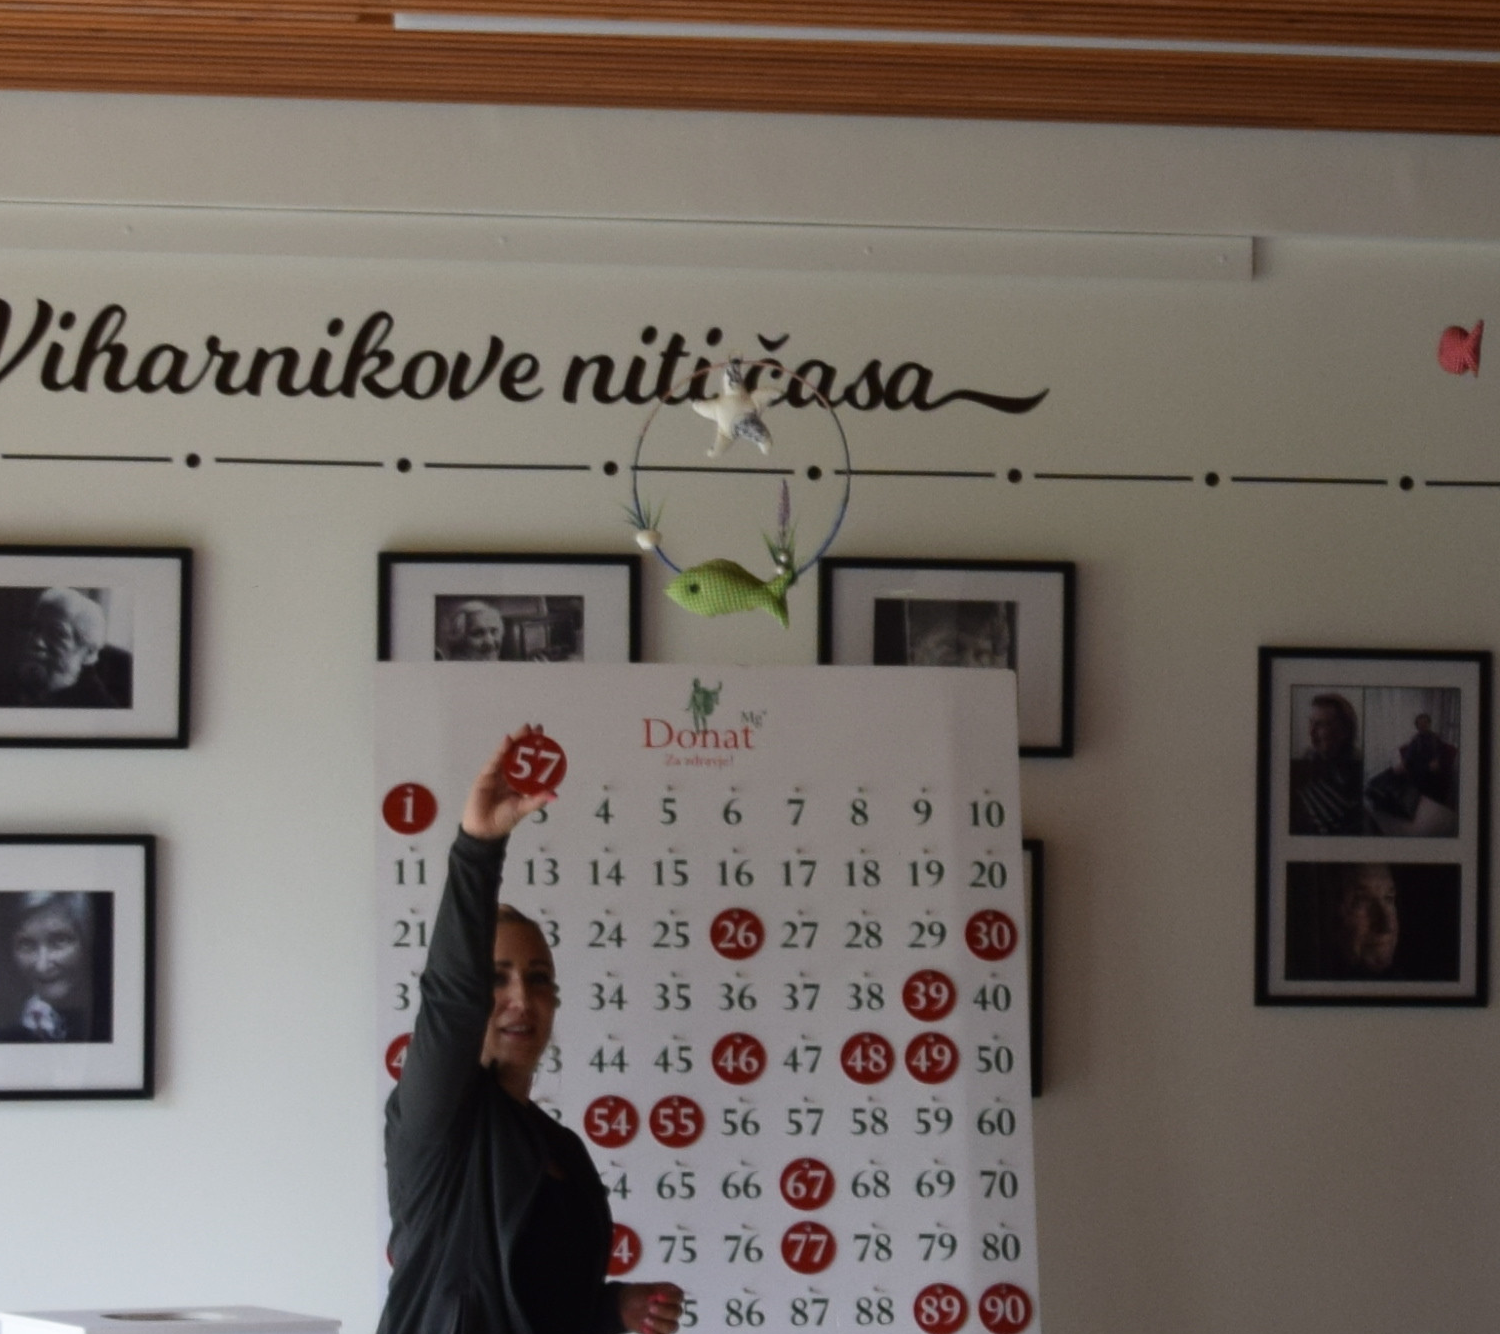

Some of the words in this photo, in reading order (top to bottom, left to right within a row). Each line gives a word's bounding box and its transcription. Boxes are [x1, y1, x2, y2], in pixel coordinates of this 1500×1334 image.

[642, 718, 755, 750] Donat
[509, 747, 561, 784] 57
[403, 795, 414, 824] 1
[595, 799, 613, 825] 4
[662, 797, 677, 825] 5
[722, 799, 743, 825] 6
[787, 798, 805, 826] 7
[850, 799, 869, 826] 8
[912, 799, 933, 824] 9
[970, 800, 1005, 828] 10
[396, 858, 426, 885] 11
[526, 857, 560, 886] 13
[590, 859, 625, 887] 14
[655, 859, 689, 887] 15
[719, 860, 754, 887] 16
[782, 859, 817, 888] 17
[846, 860, 881, 887] 18
[909, 859, 945, 887] 19
[969, 860, 1008, 889] 20
[392, 920, 428, 948] 21
[588, 920, 626, 948] 24
[652, 920, 690, 948] 25
[718, 919, 758, 949] 26
[781, 920, 819, 949] 27
[845, 921, 883, 949] 28
[908, 920, 947, 949] 29
[972, 921, 1011, 949] 30
[590, 982, 627, 1011] 34
[655, 982, 692, 1011] 35
[719, 982, 757, 1011] 36
[783, 982, 821, 1011] 37
[848, 982, 885, 1011] 38
[911, 980, 950, 1010] 39
[973, 984, 1012, 1011] 40
[589, 1046, 628, 1073] 44
[654, 1045, 693, 1073] 45
[717, 1045, 759, 1073] 46
[783, 1045, 822, 1073] 47
[847, 1044, 887, 1073] 48
[911, 1043, 952, 1073] 49
[977, 1045, 1014, 1074] 50
[593, 1107, 631, 1137] 54
[658, 1107, 696, 1137] 55
[723, 1108, 761, 1136] 56
[786, 1107, 824, 1136] 57
[852, 1107, 889, 1135] 58
[916, 1107, 954, 1135] 59
[976, 1108, 1016, 1136] 60
[656, 1171, 696, 1199] 65
[721, 1173, 762, 1199] 66
[785, 1169, 827, 1199] 67
[851, 1170, 891, 1198] 68
[915, 1169, 956, 1198] 69
[979, 1170, 1019, 1199] 70
[658, 1235, 697, 1264] 75
[724, 1234, 764, 1263] 76
[787, 1232, 828, 1263] 77
[853, 1233, 893, 1262] 78
[918, 1232, 958, 1261] 79
[982, 1233, 1021, 1261] 80
[725, 1299, 765, 1327] 86
[790, 1297, 829, 1326] 87
[855, 1298, 895, 1325] 88
[920, 1294, 961, 1325] 89
[984, 1294, 1026, 1324] 90
